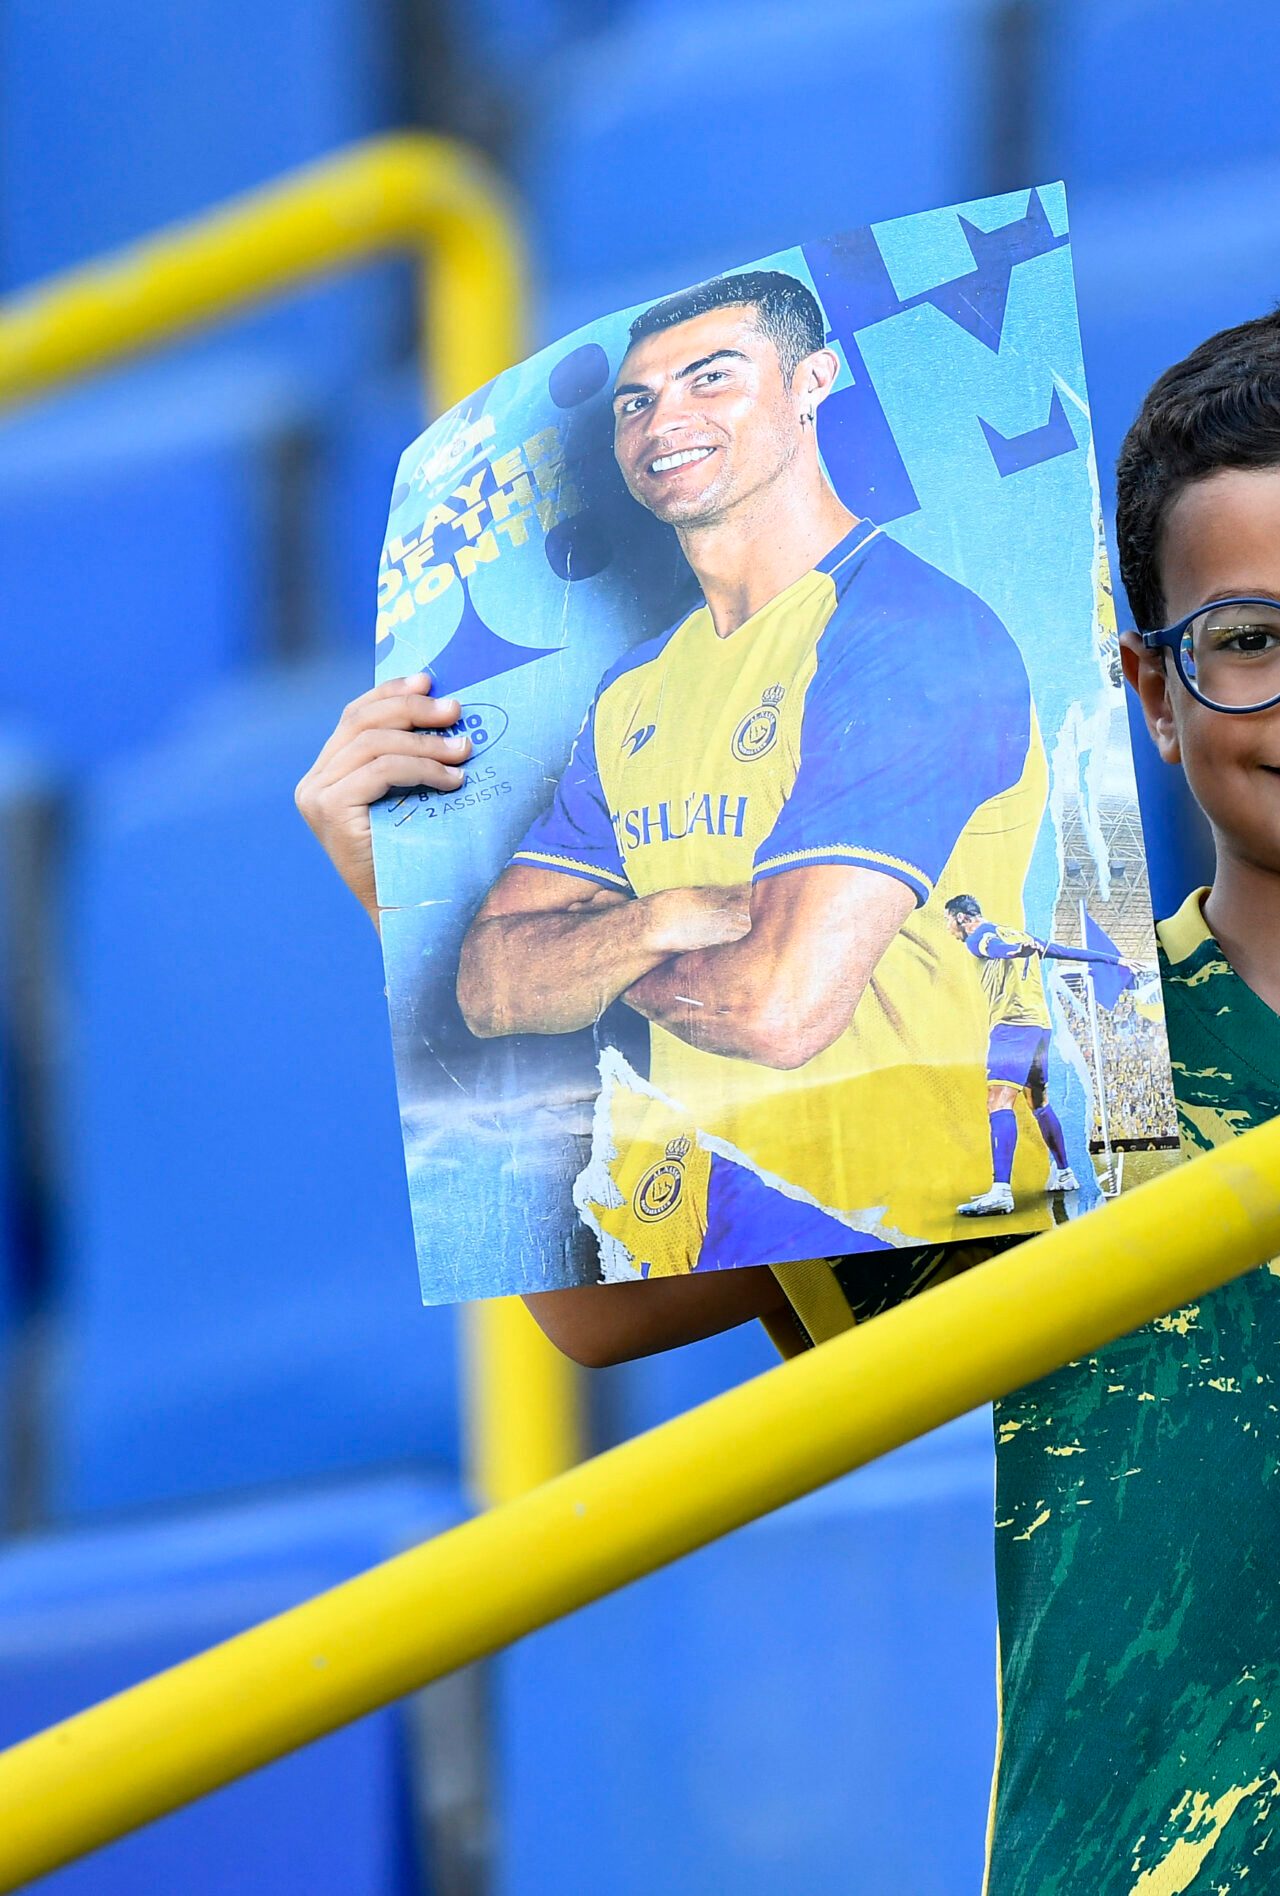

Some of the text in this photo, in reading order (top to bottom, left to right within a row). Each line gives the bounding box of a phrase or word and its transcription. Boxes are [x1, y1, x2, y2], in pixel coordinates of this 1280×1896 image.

[379, 427, 566, 568] LAYER
[377, 537, 436, 609] OF
[425, 781, 513, 818] 2 ASSISTS
